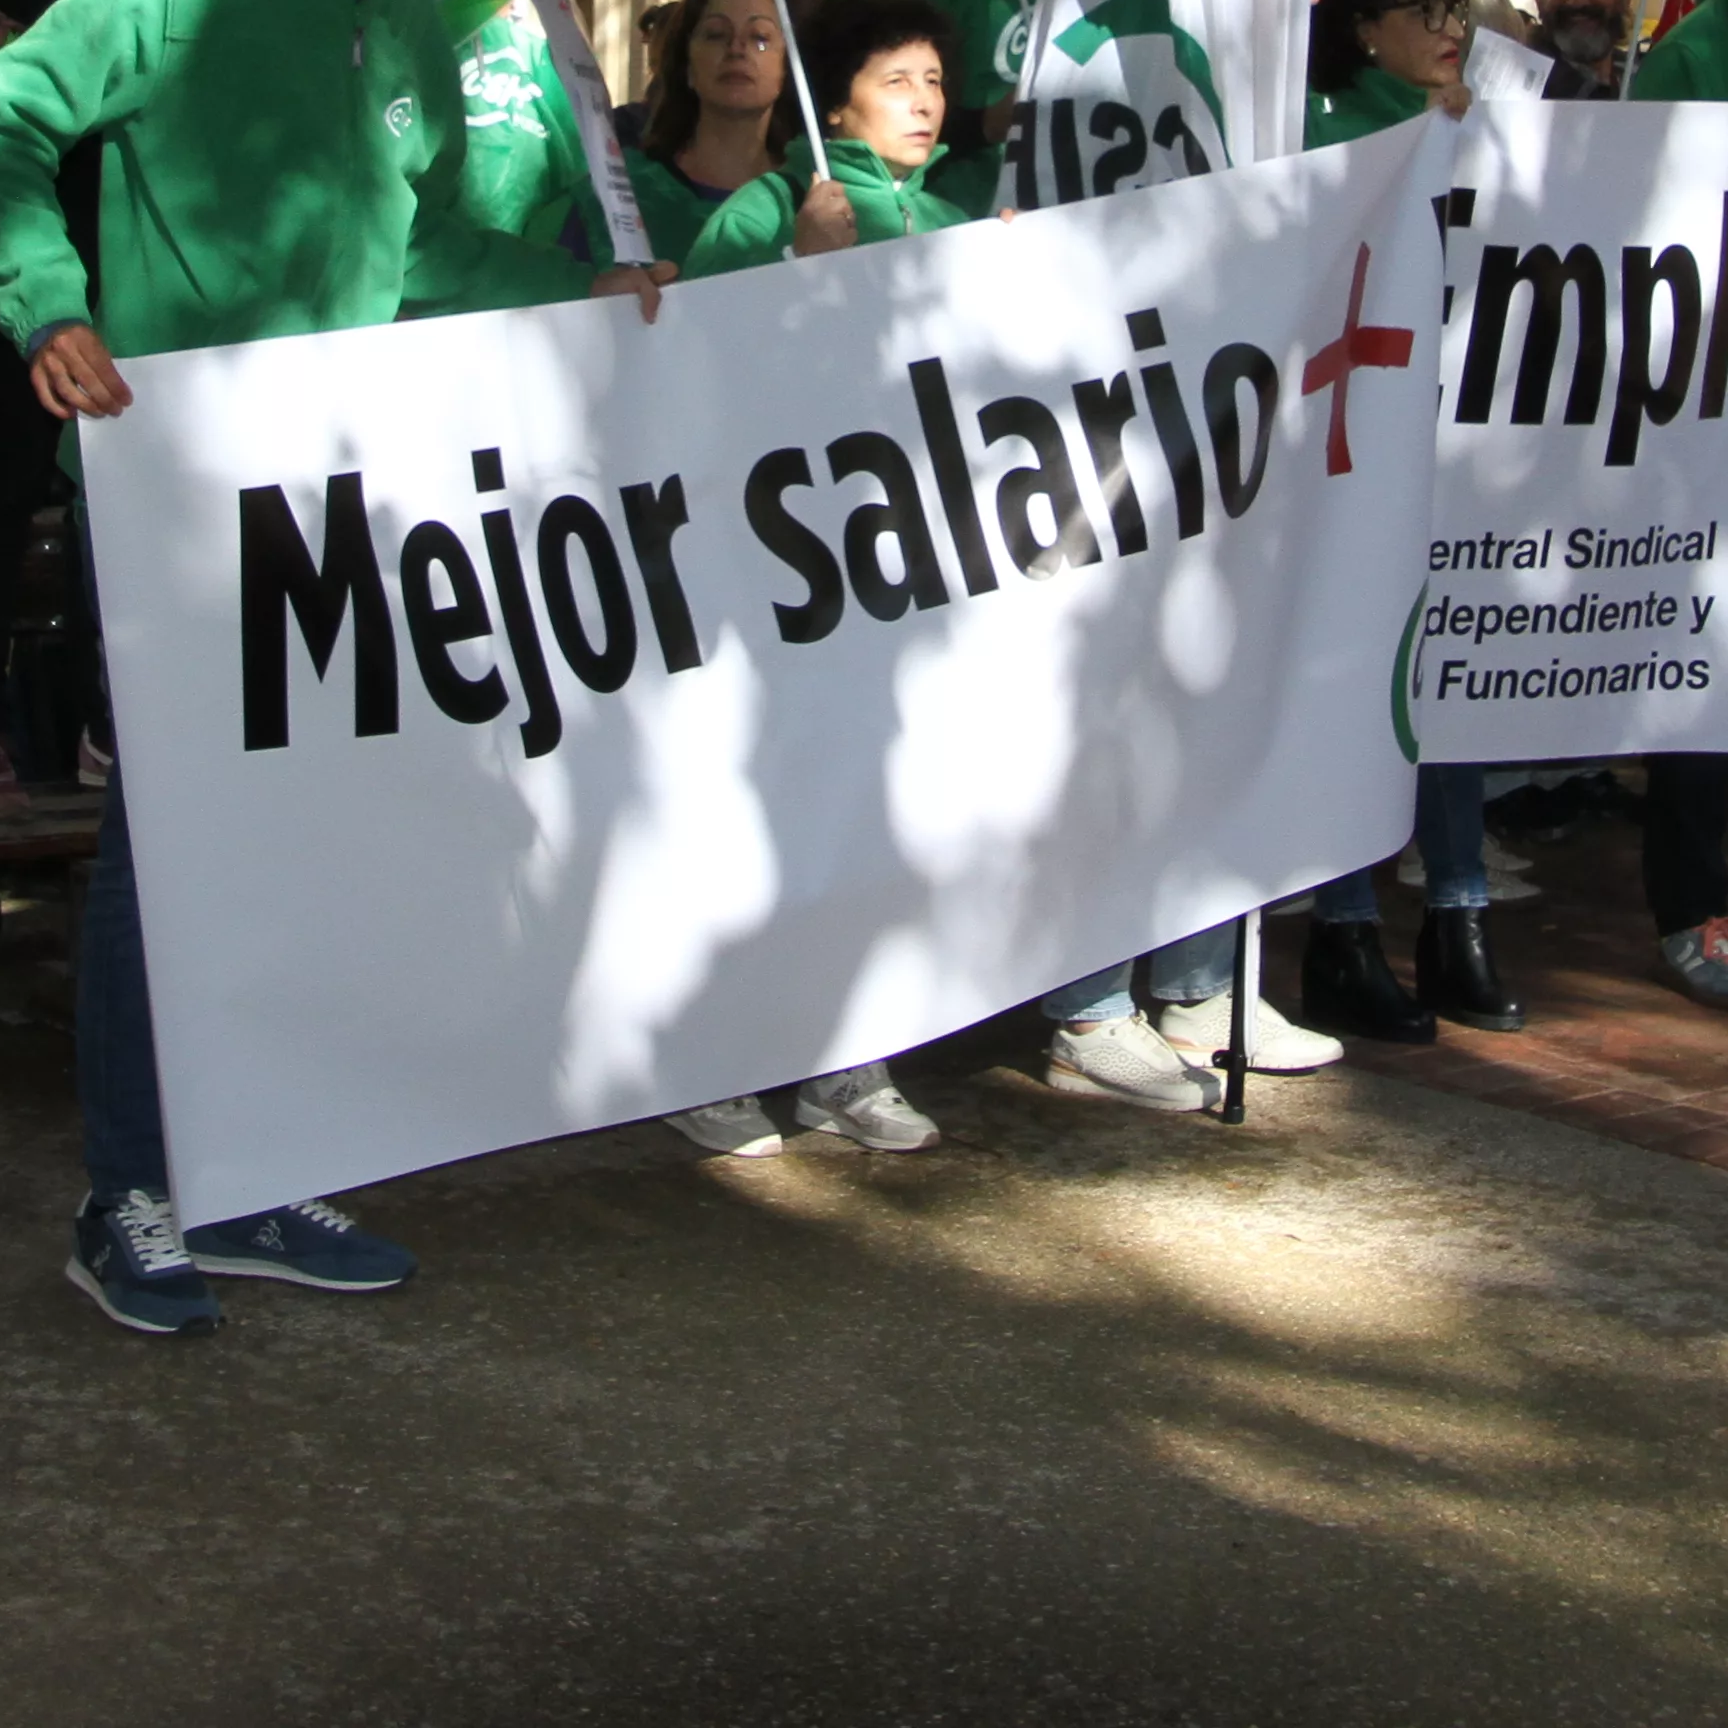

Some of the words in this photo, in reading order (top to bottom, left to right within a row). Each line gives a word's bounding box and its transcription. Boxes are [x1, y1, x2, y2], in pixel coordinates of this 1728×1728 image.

[239, 446, 703, 759] Mejor
[744, 307, 1279, 644] salario
[1564, 521, 1718, 570] Sindical
[1689, 594, 1716, 635] y
[1437, 650, 1711, 701] Funcionarios
